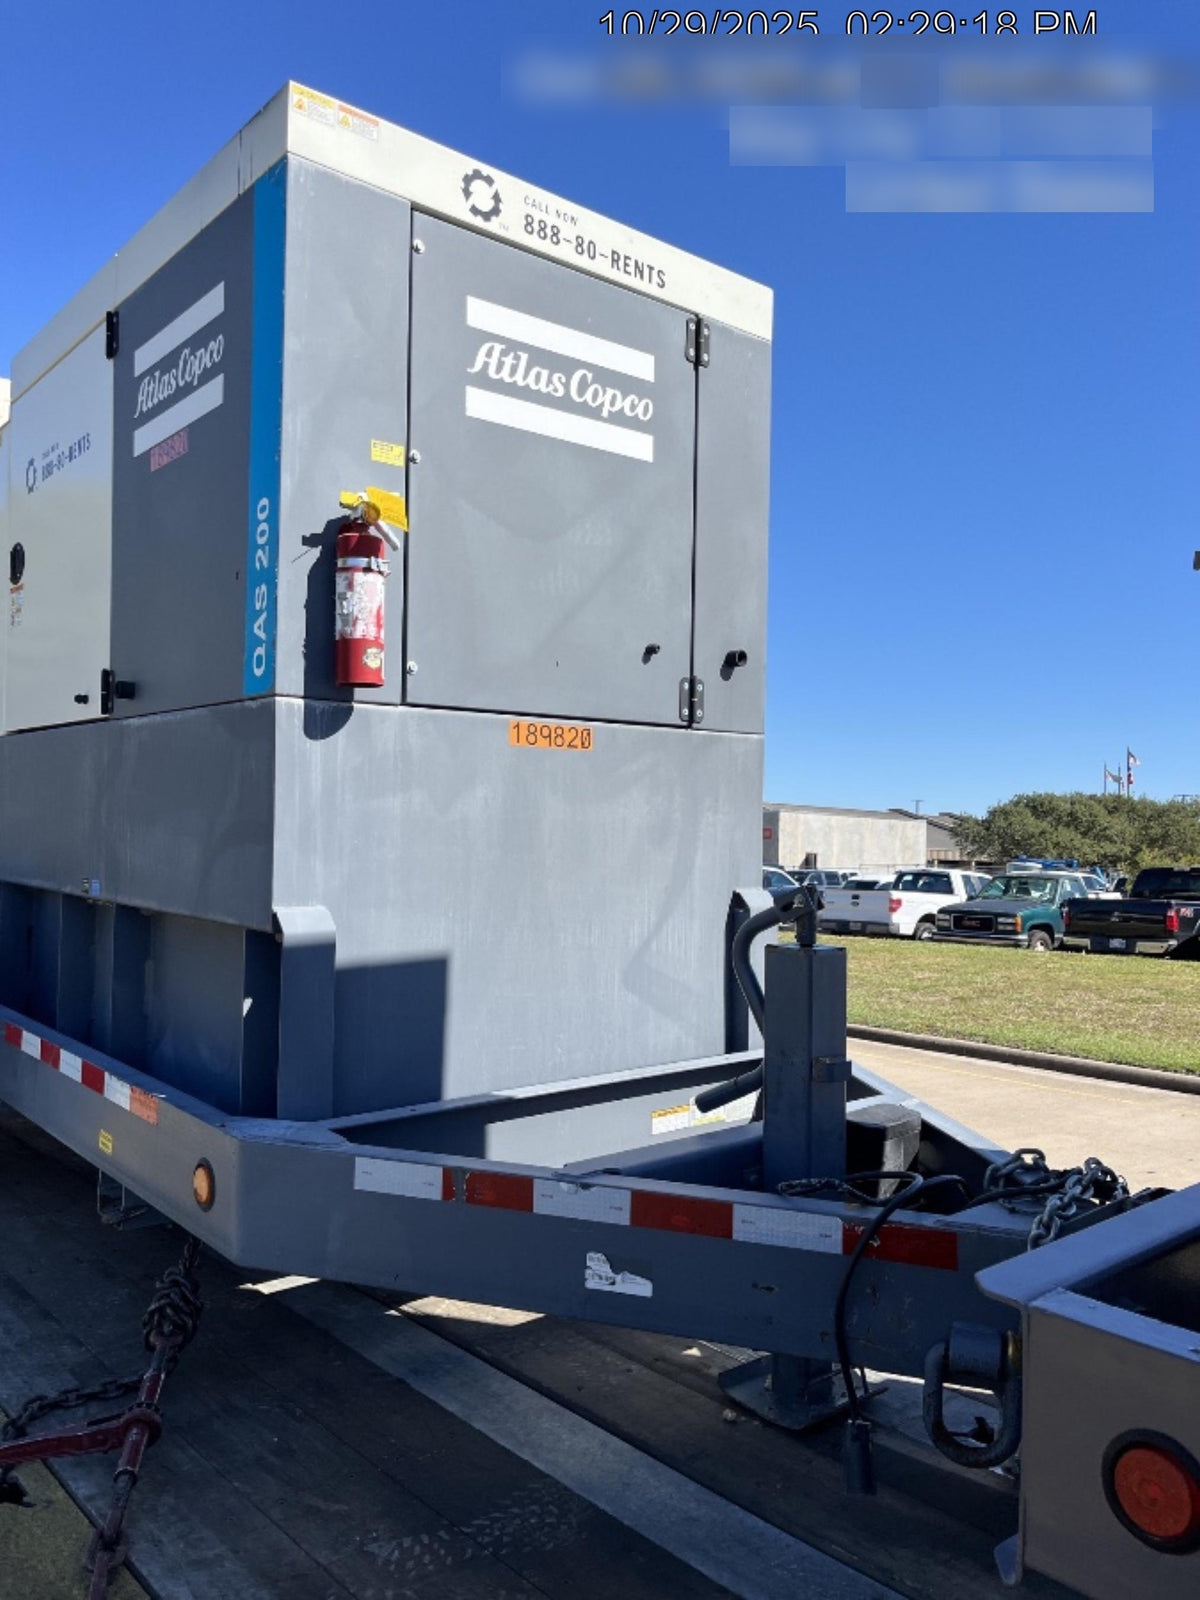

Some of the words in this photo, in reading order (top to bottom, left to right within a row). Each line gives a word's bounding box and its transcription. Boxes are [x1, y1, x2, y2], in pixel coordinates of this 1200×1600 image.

[523, 195, 550, 216] CALL
[555, 209, 579, 227] NOW
[523, 214, 667, 289] 888-80-RENTS
[133, 369, 177, 418] Atlas
[177, 333, 225, 387] Copco
[467, 342, 567, 398] Atlas
[569, 369, 654, 422] Copco
[255, 496, 270, 571] 200
[252, 583, 268, 678] QAS
[512, 721, 592, 750] 189820
